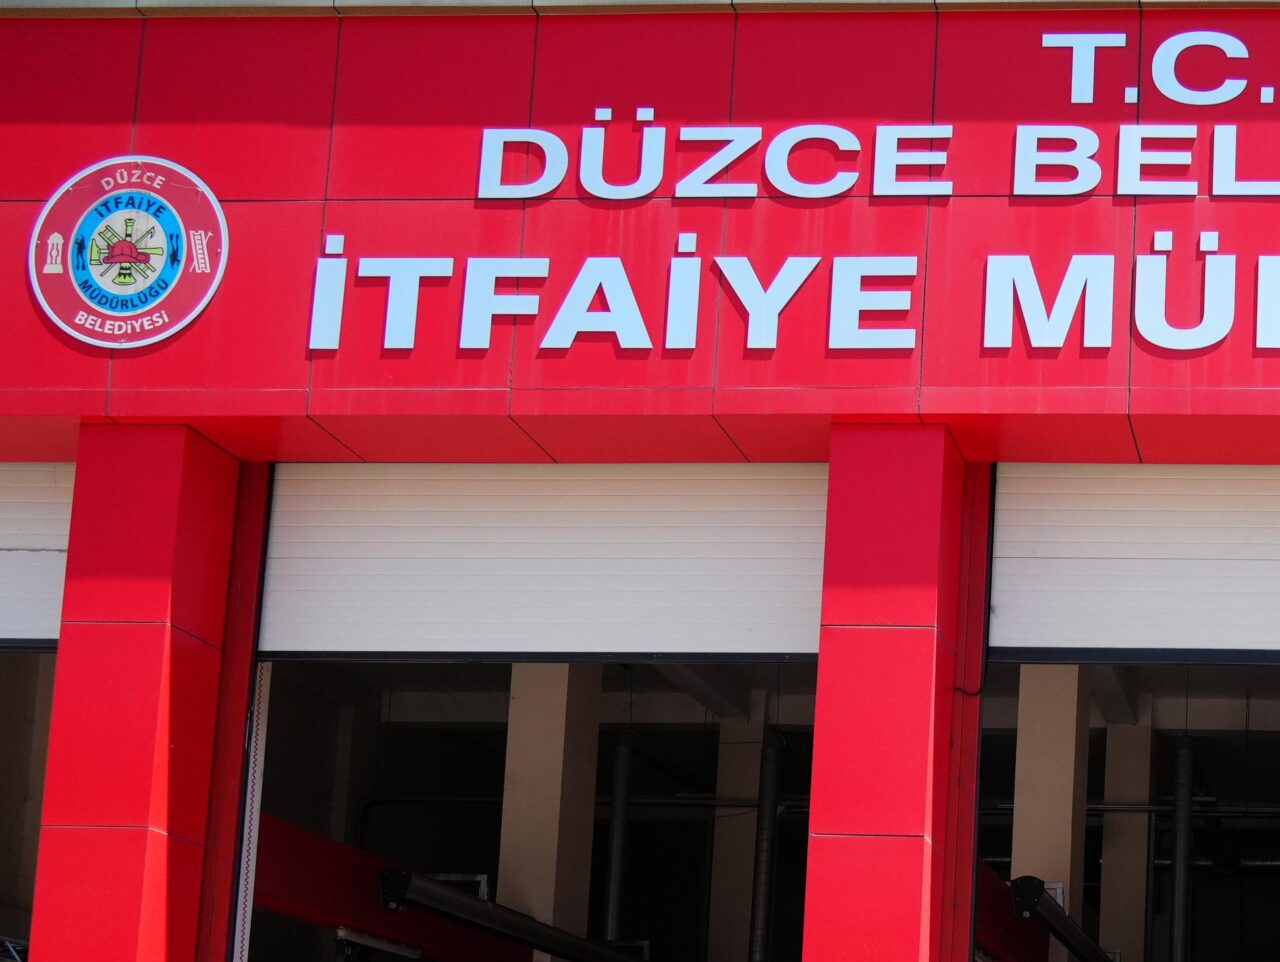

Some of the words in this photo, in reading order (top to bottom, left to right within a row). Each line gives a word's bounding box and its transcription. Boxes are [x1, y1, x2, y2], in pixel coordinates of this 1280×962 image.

[1042, 31, 1276, 105] T.C.
[478, 107, 954, 200] DÜZCE
[101, 169, 166, 191] DÜZCE
[94, 196, 167, 219] İTFAİYE
[309, 232, 918, 350] İTFAİYE
[74, 310, 169, 335] BELEDİYESİ
